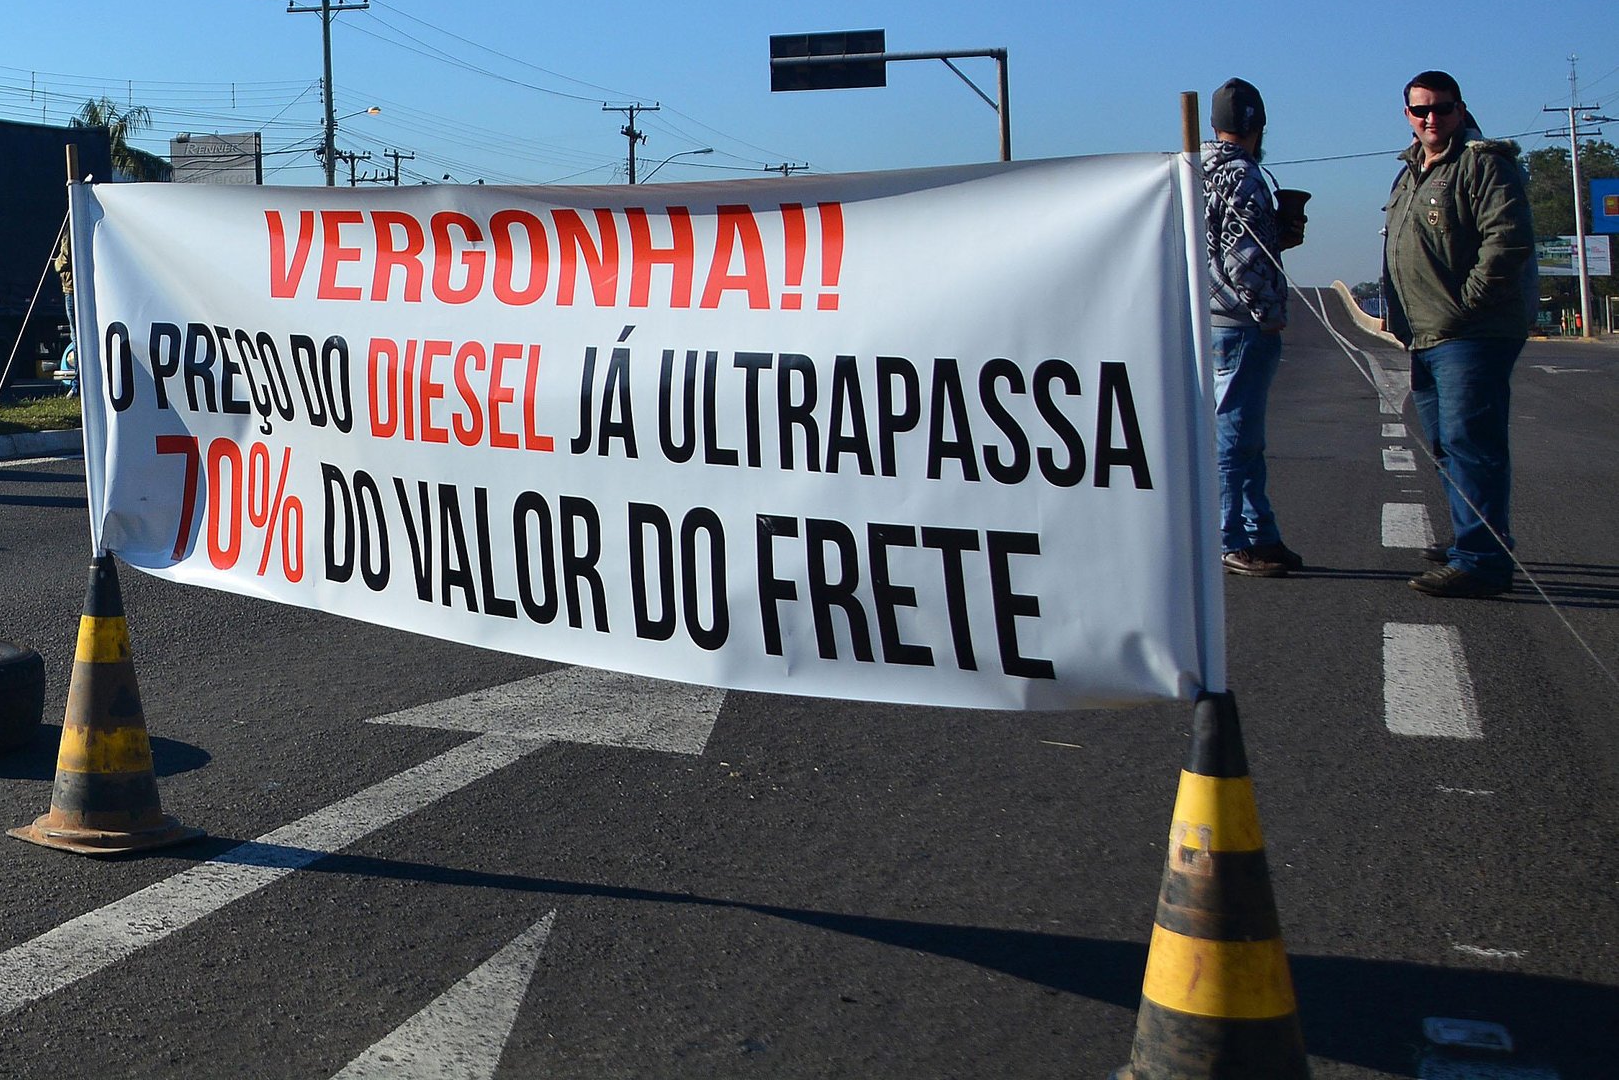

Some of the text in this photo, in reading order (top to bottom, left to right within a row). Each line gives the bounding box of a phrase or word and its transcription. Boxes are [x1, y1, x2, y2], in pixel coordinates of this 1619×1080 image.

[184, 142, 240, 155] RENNER
[265, 203, 844, 311] VERGONHA!!
[105, 321, 1154, 490] O PREÇO DO DIESEL JÁ ULTRAPASSA
[155, 434, 1058, 681] 70% DO VALOR DO FRETE
